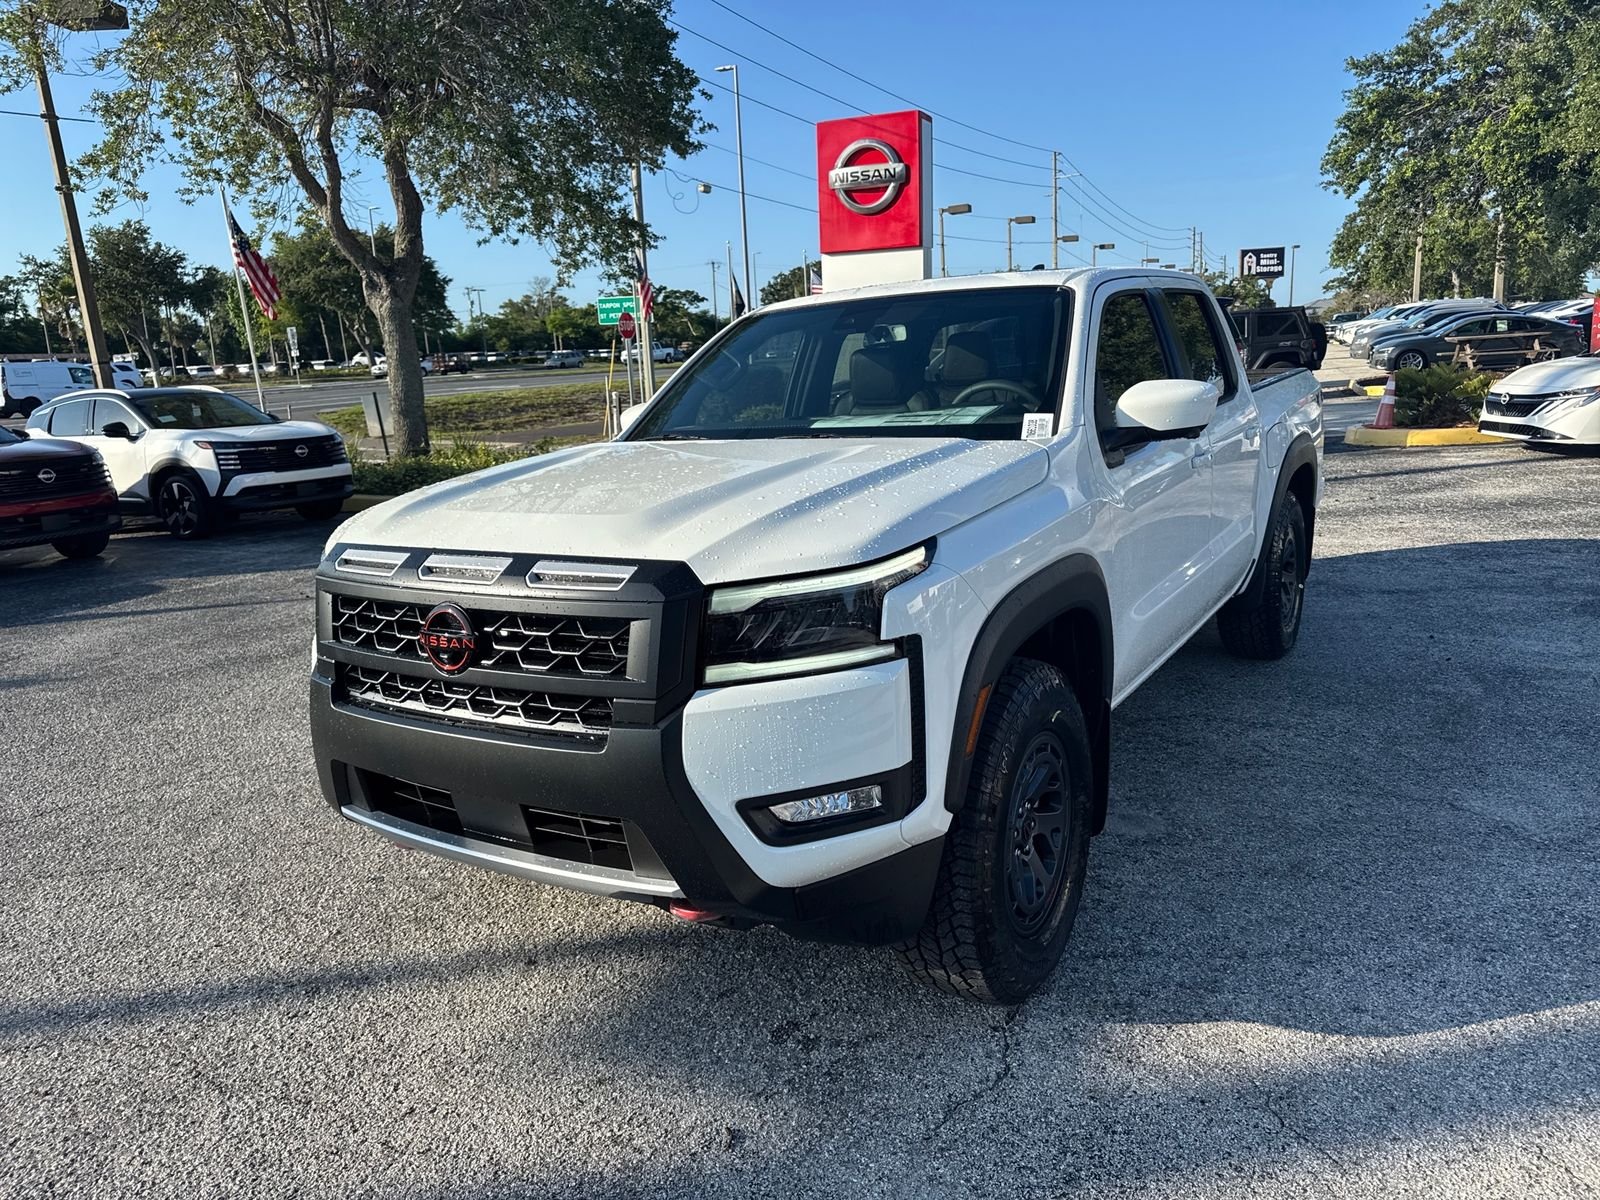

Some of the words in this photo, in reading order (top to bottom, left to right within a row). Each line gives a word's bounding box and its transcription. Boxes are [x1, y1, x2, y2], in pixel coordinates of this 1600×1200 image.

[834, 167, 897, 184] NISSAN
[620, 320, 635, 331] STOP
[420, 634, 474, 648] NISSAN
